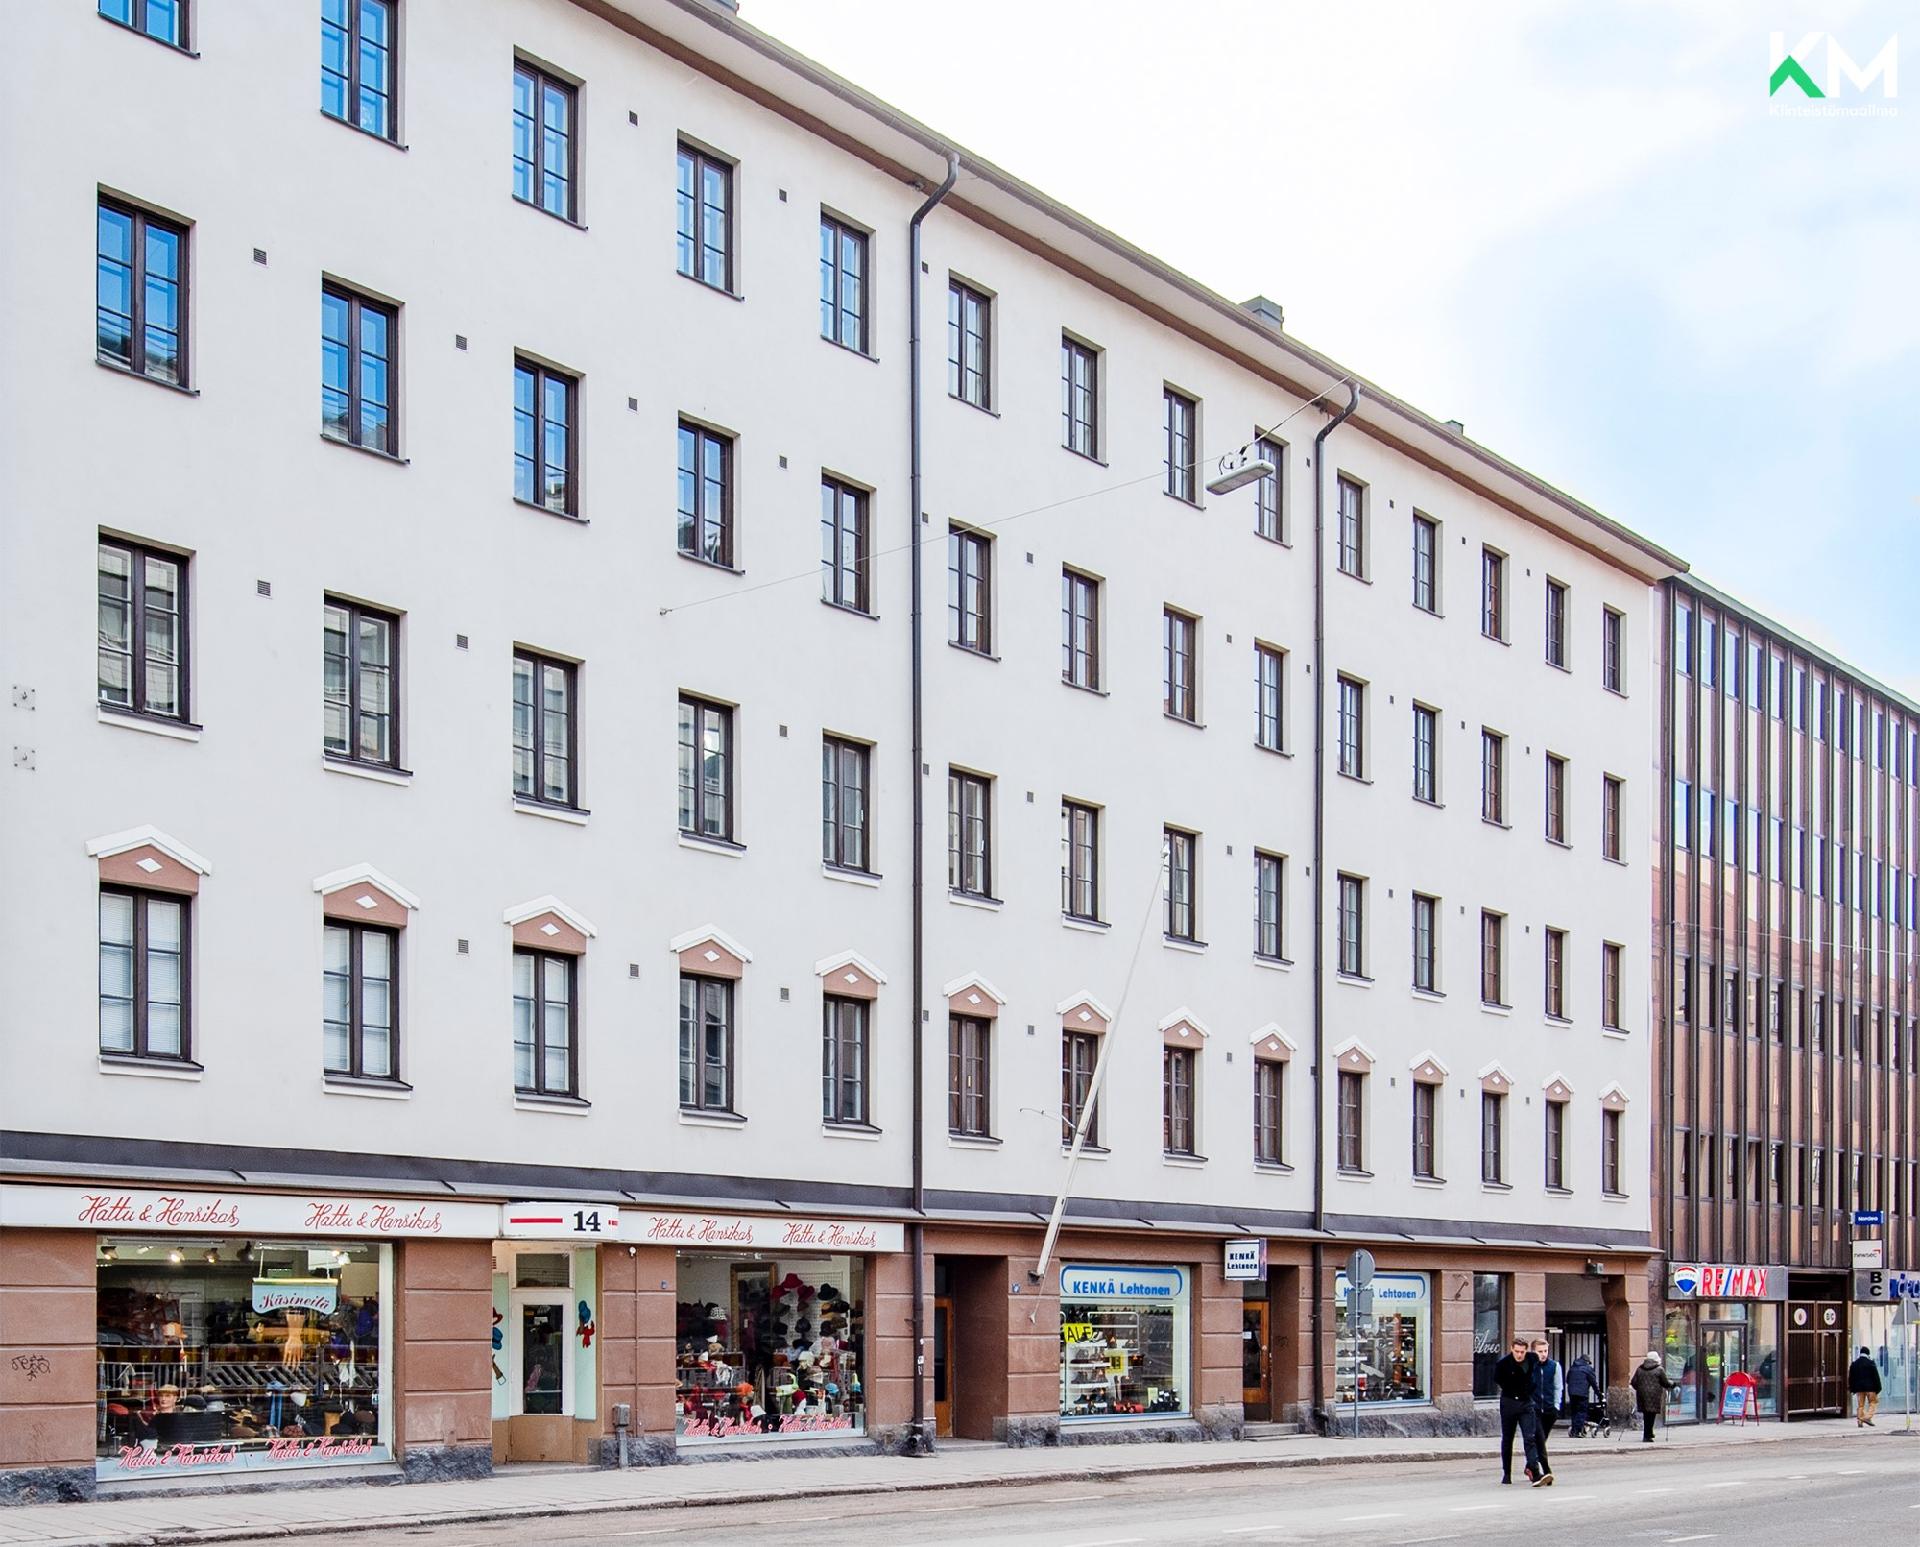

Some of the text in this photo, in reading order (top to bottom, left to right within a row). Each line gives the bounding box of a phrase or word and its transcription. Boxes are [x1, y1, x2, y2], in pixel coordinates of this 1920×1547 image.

[78, 1195, 240, 1227] Hattu & Hansikas
[304, 1202, 442, 1232] Hattu & Hansikas
[573, 1210, 601, 1232] 14
[647, 1216, 754, 1245] Hattu & Hansikas
[782, 1222, 877, 1249] Hattu & Hansikas
[1226, 1262, 1258, 1270] Lehtonen
[1229, 1250, 1256, 1260] KENKÄ
[1072, 1278, 1171, 1296] KENKÄ Lehtonen
[1702, 1267, 1768, 1297] RE/MAX
[1869, 1271, 1883, 1284] B
[1869, 1285, 1883, 1297] C
